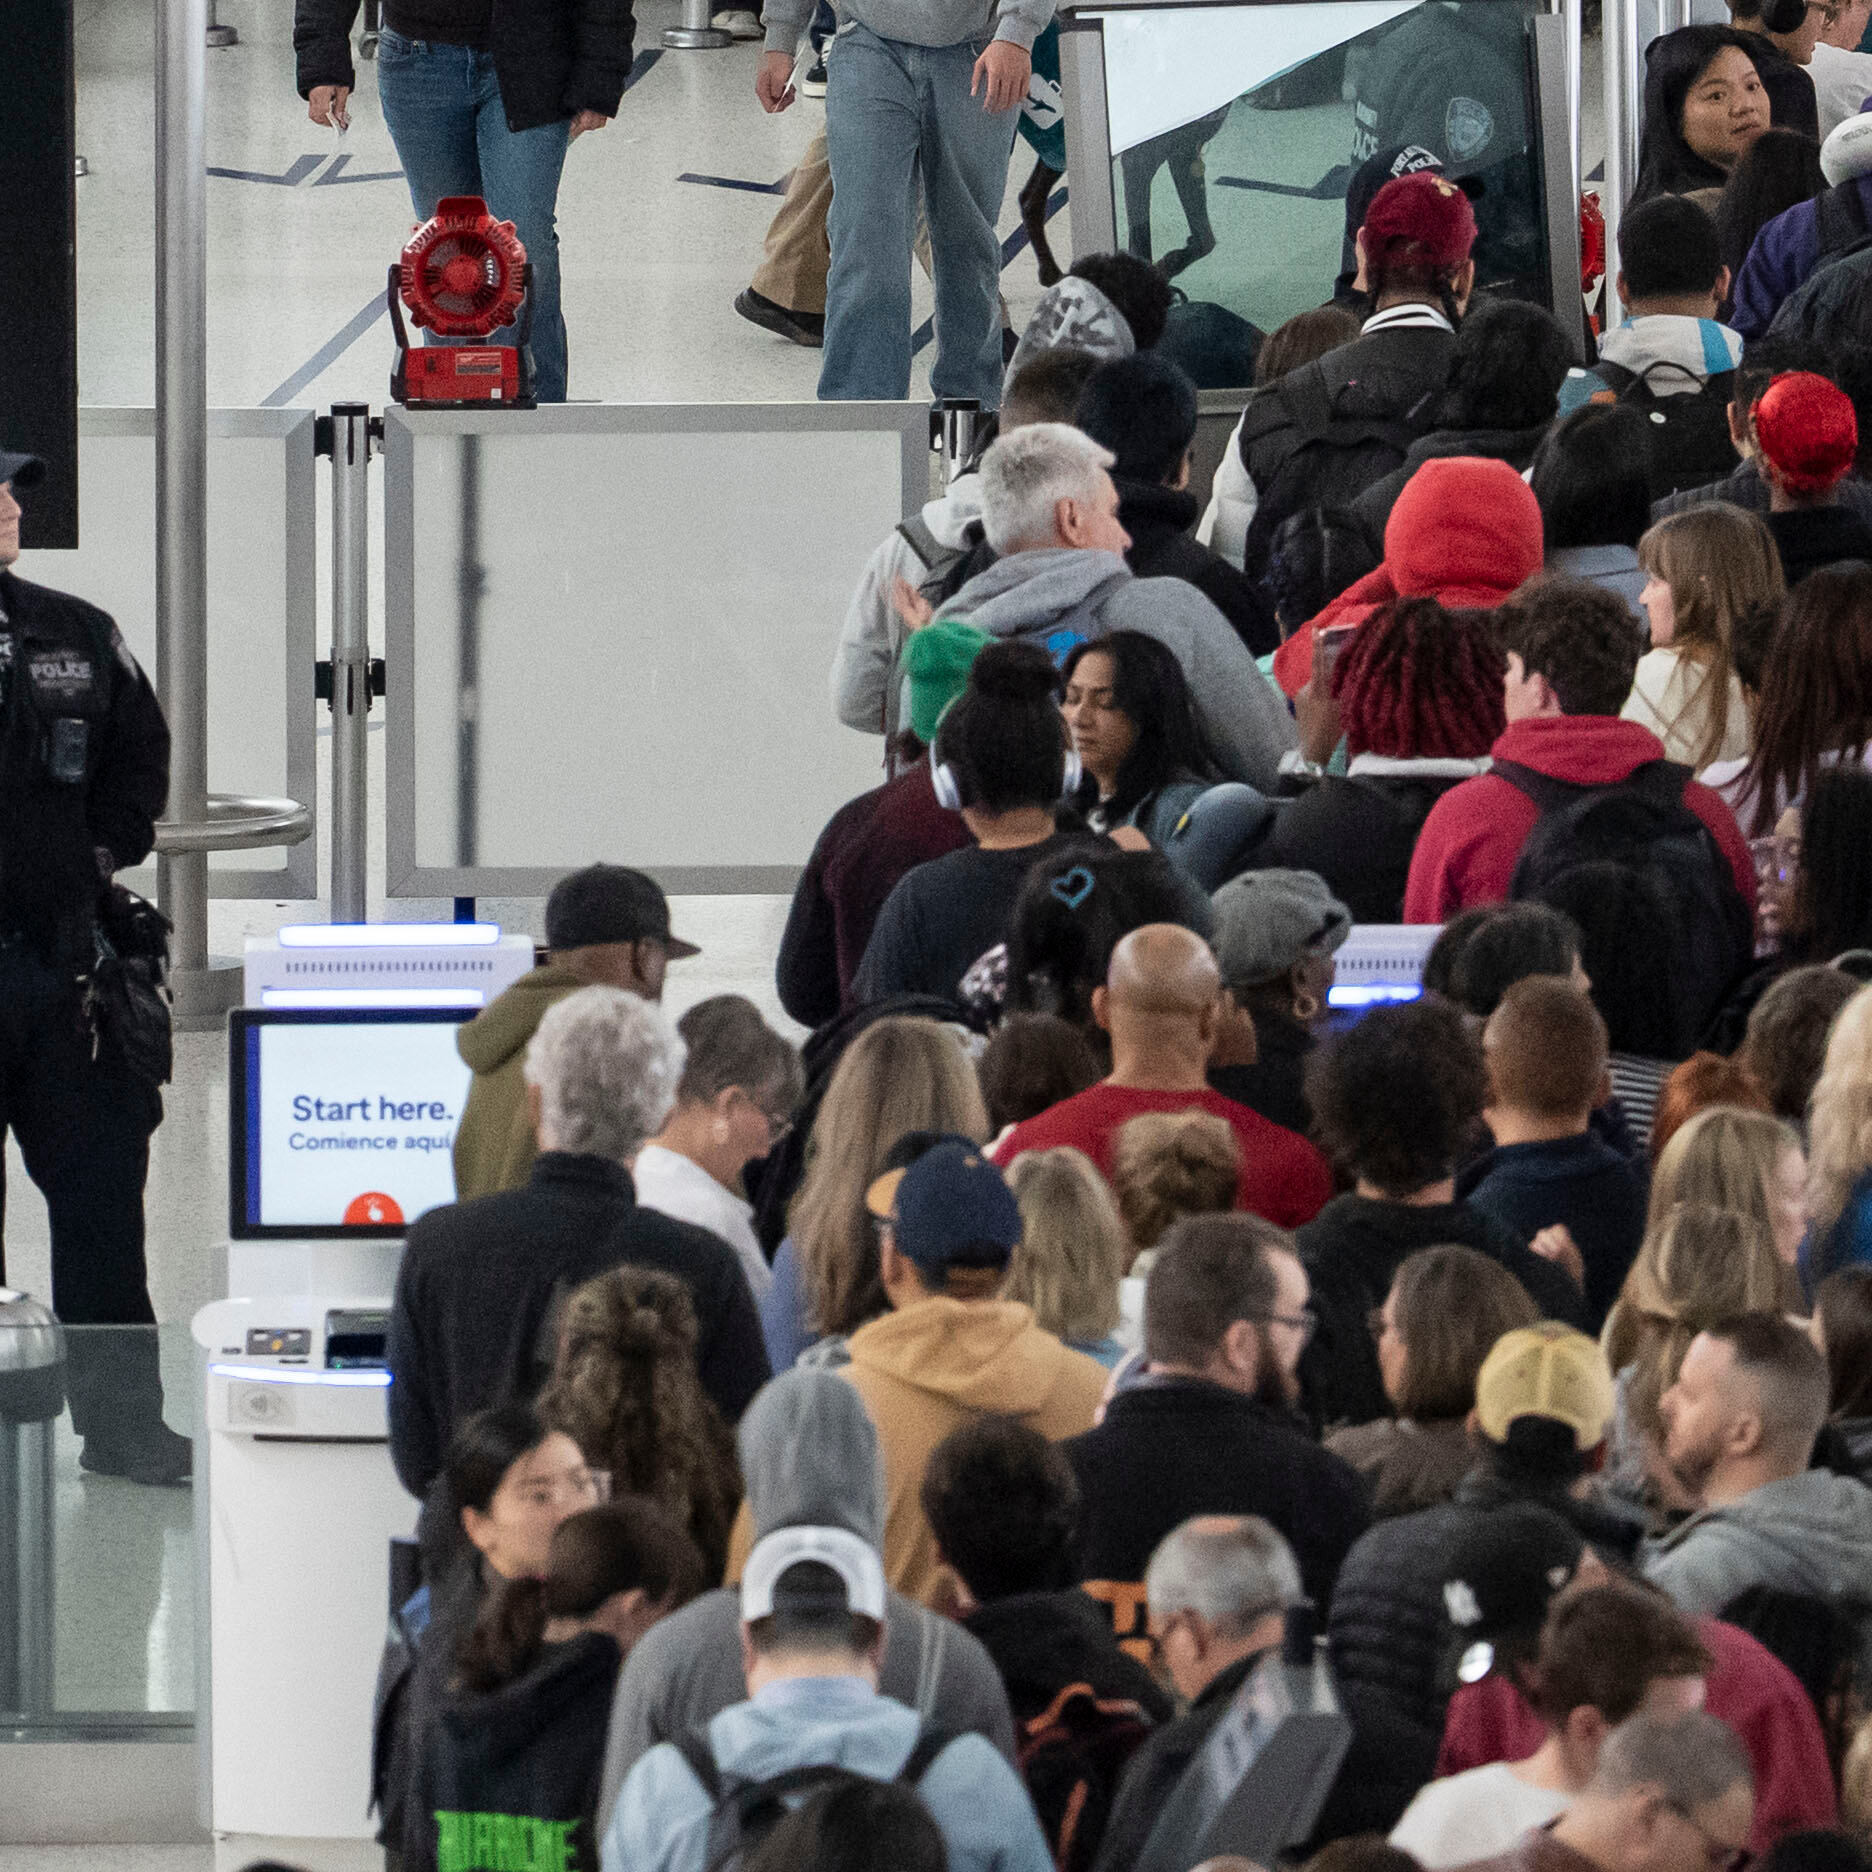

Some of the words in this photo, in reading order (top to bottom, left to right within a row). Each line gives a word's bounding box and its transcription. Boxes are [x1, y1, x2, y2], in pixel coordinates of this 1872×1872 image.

[293, 1095, 370, 1121] Start
[380, 1096, 453, 1120] here.
[289, 1133, 398, 1150] Comience
[405, 1131, 450, 1153] aquí
